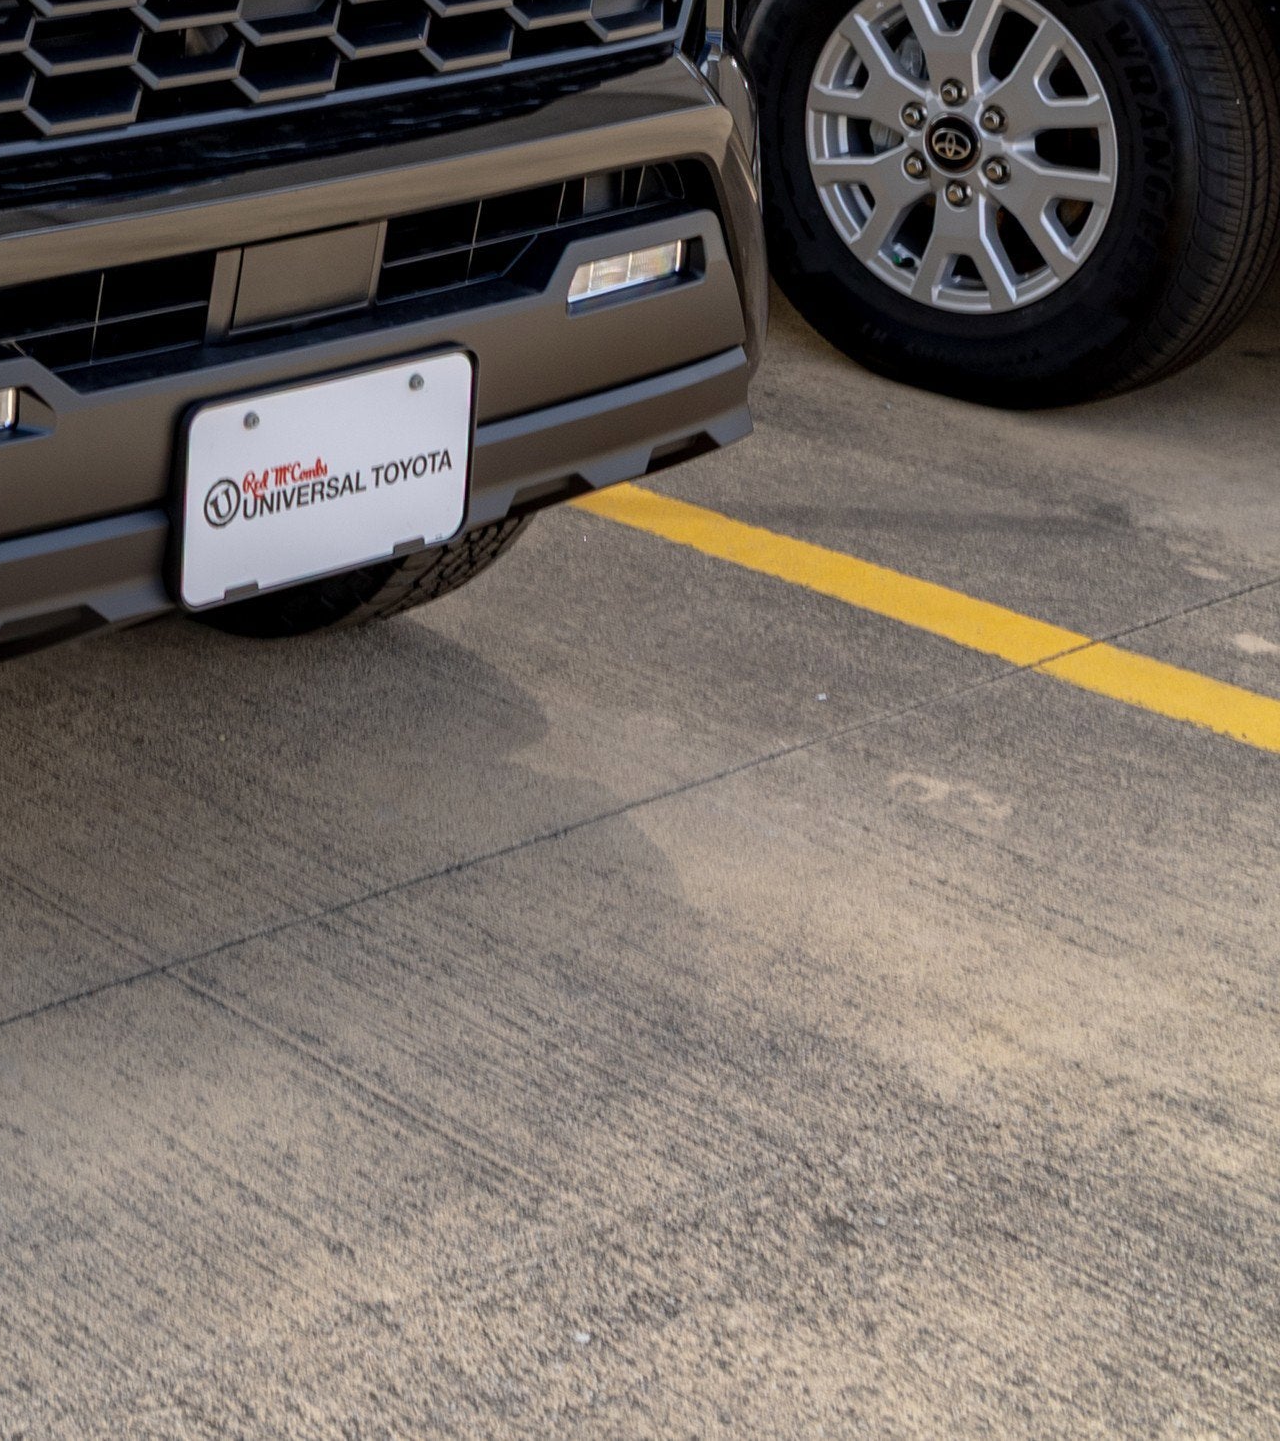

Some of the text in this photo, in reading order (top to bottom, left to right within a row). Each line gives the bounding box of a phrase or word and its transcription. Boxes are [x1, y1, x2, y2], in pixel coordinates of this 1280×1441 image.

[242, 465, 269, 499] Red
[243, 448, 453, 521] UNIVERSAL TOYOTA
